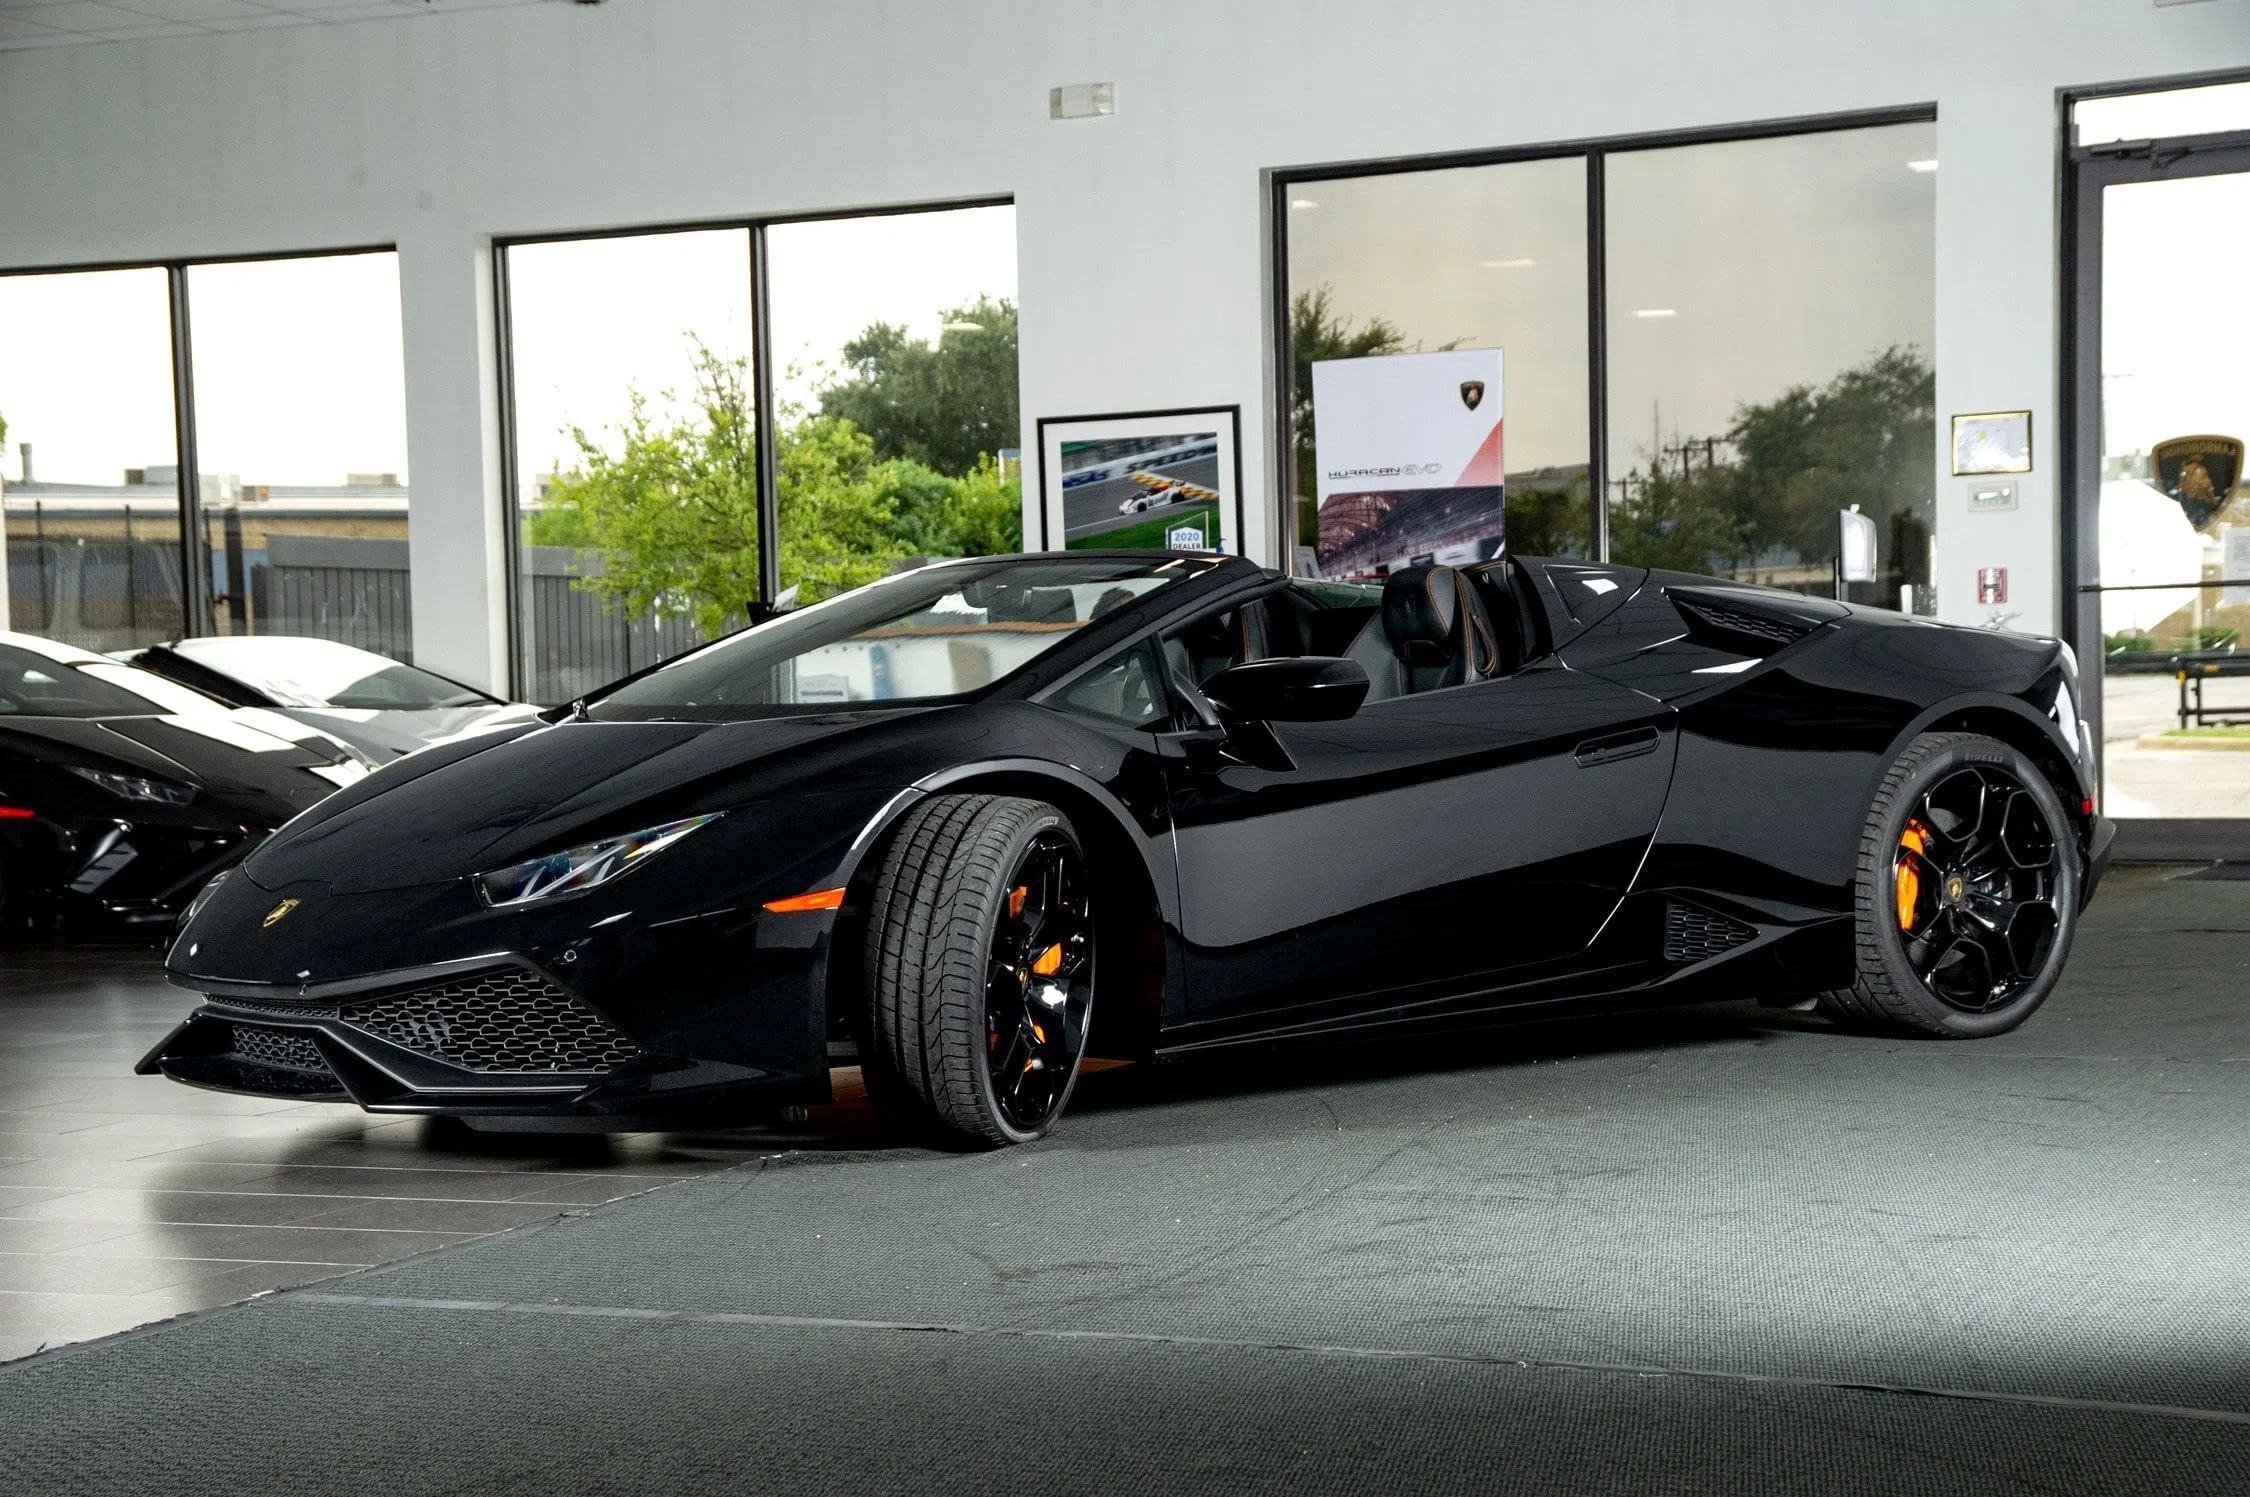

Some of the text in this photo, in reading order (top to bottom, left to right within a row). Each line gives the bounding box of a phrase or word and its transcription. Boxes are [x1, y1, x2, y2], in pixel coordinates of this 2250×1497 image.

[1401, 462, 1441, 475] EVO
[1174, 532, 1200, 542] 2020
[1173, 542, 1201, 550] DEALER
